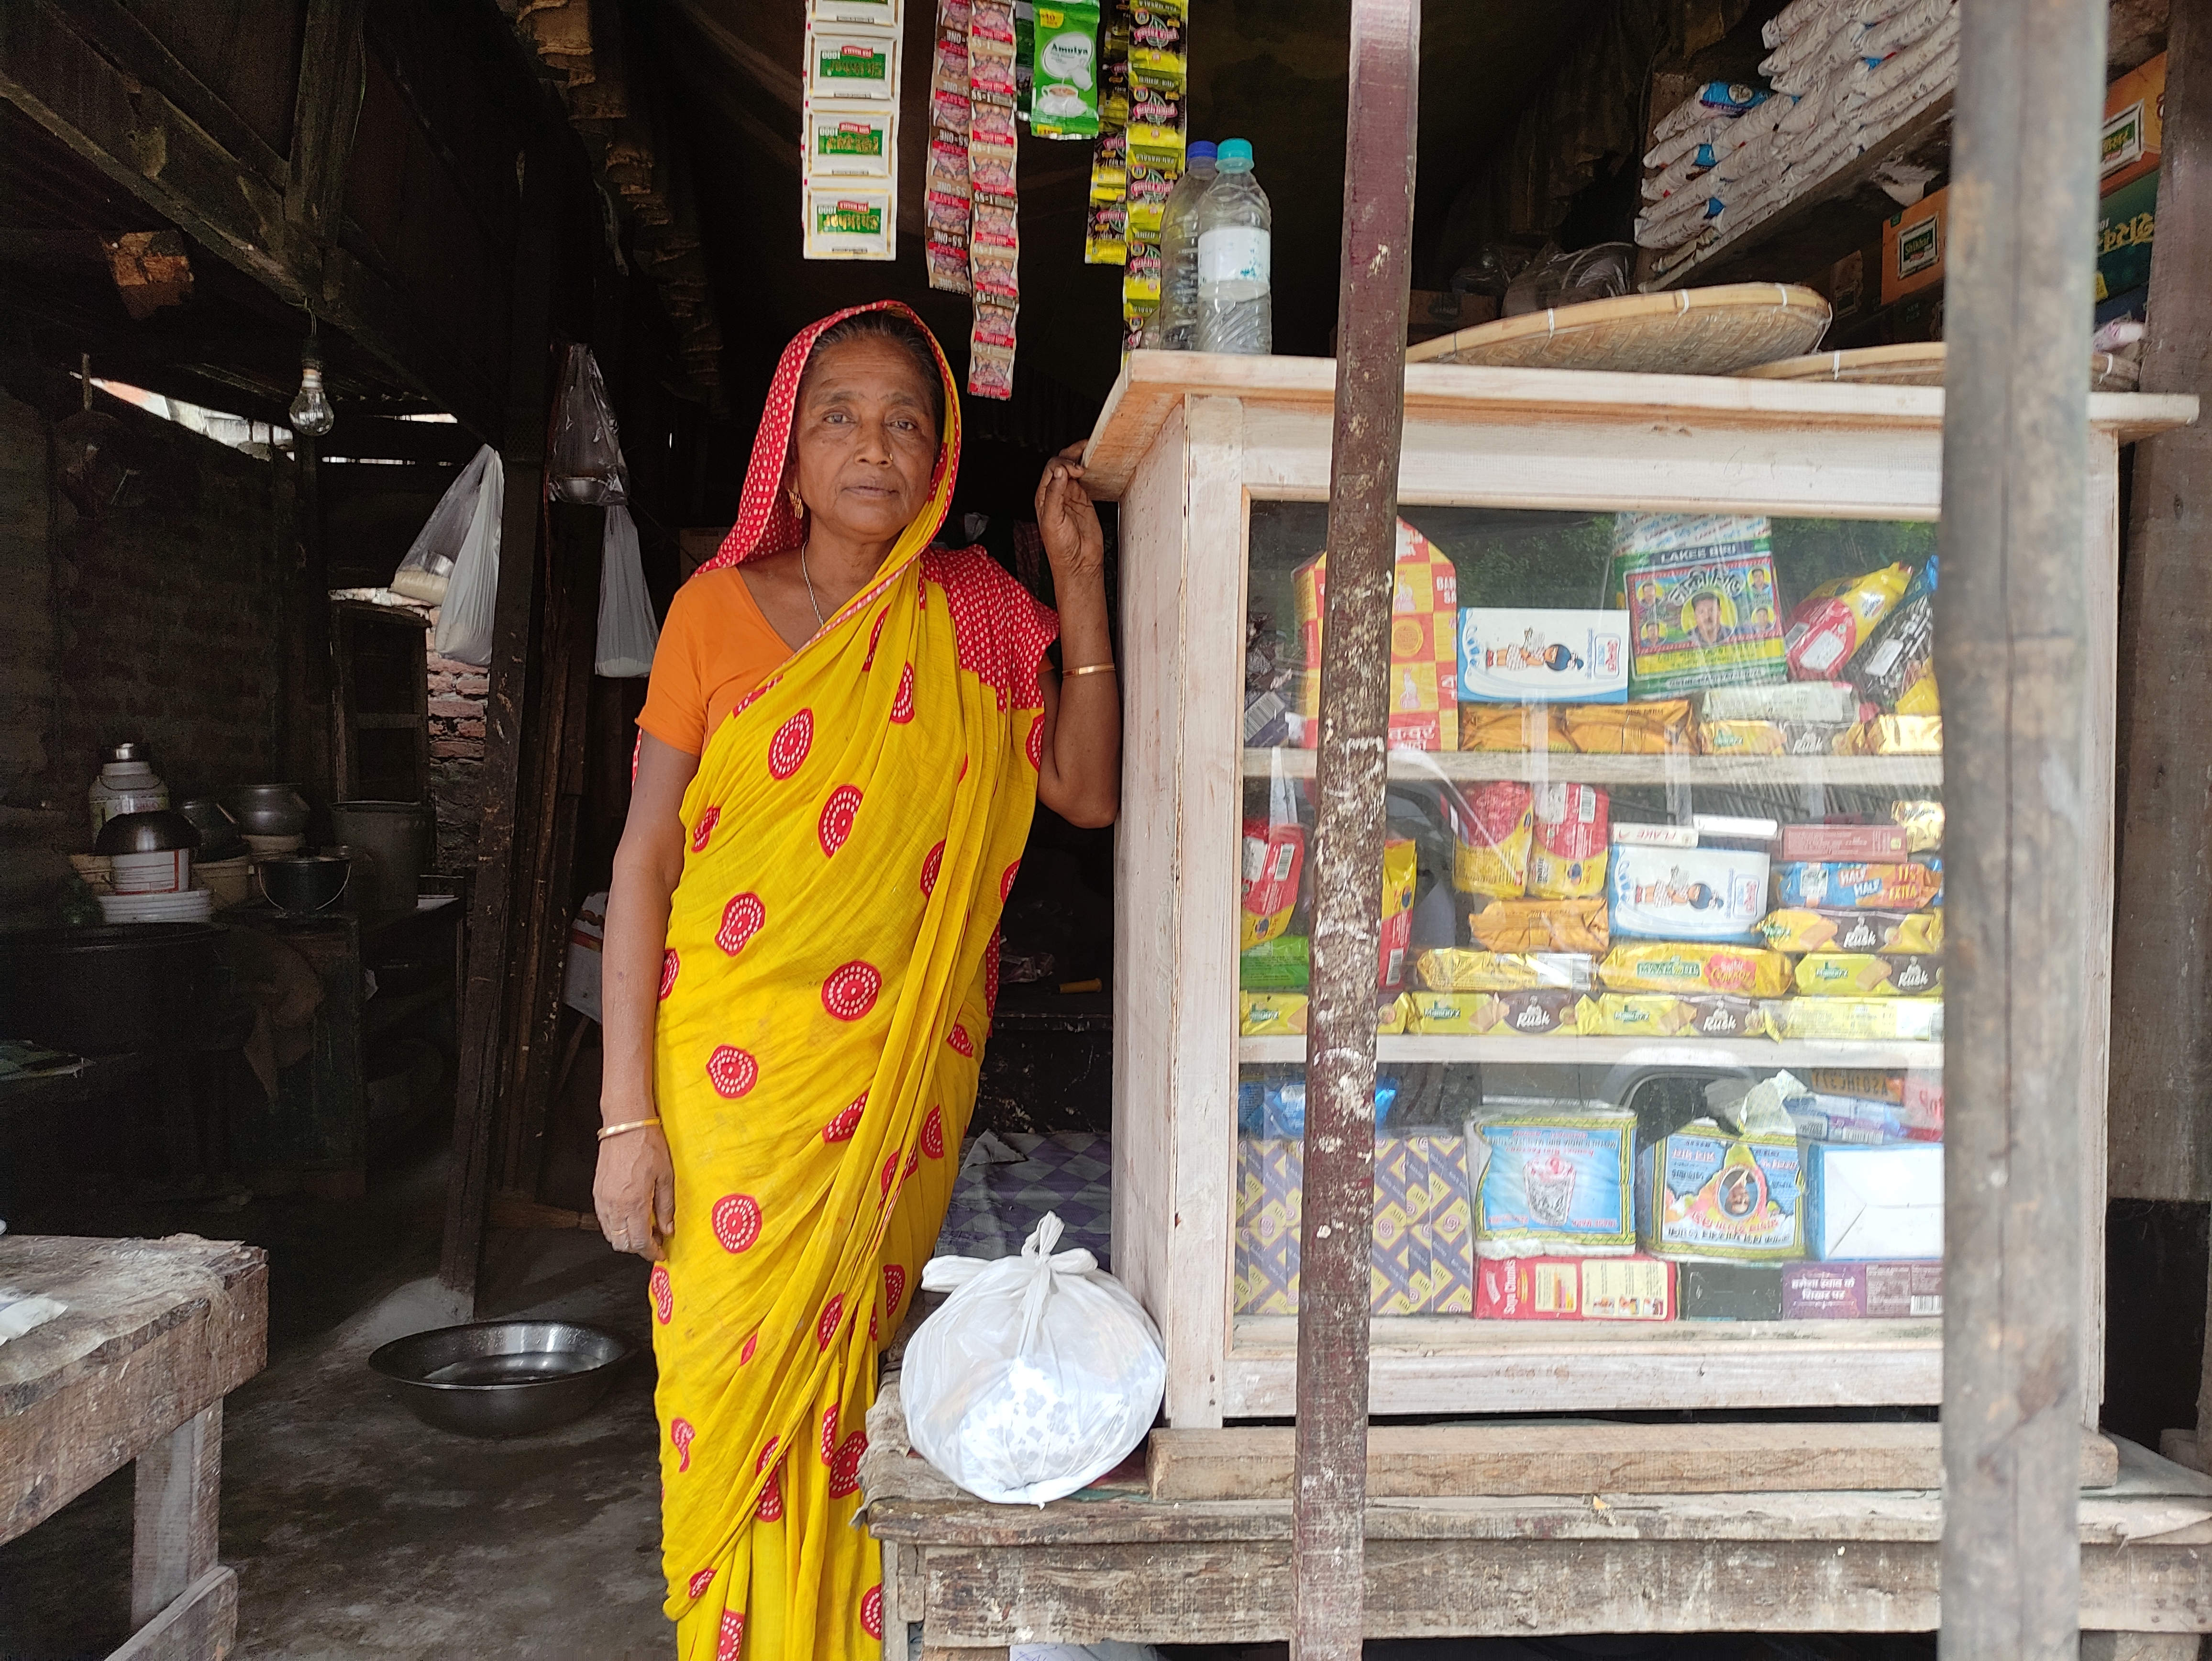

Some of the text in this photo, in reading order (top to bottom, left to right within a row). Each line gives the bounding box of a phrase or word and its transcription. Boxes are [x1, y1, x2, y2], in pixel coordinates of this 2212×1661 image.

[1052, 43, 1088, 55] Amulya
[1136, 154, 1174, 165] PAN MASALA
[1905, 236, 1929, 255] Shikhar
[1660, 543, 1737, 564] LAKEE BIRI
[1793, 737, 1824, 755] Rusk
[1636, 830, 1677, 842] FLAKE
[1838, 868, 1867, 887] HALF
[1853, 878, 1881, 897] HALF
[1889, 884, 1916, 900] EXTRA
[1843, 929, 1876, 948] Rusk
[1898, 970, 1929, 988] Rusk
[1516, 1009, 1550, 1029] Rusk
[1703, 1014, 1737, 1032] Rusk
[1544, 1138, 1562, 1148] BIRI
[1564, 1139, 1584, 1148] INDIA
[1247, 1179, 1260, 1193] AIM
[1432, 1179, 1443, 1193] AIM
[1415, 1190, 1427, 1205] AIM
[1391, 1208, 1404, 1221] AIM
[1250, 1271, 1262, 1285] AIM
[1434, 1267, 1446, 1281] AIM
[1236, 1280, 1249, 1296] AIM
[1418, 1277, 1430, 1291] AIM
[1503, 1259, 1518, 1315] Soya Chunks
[1399, 1297, 1411, 1312] AIM
